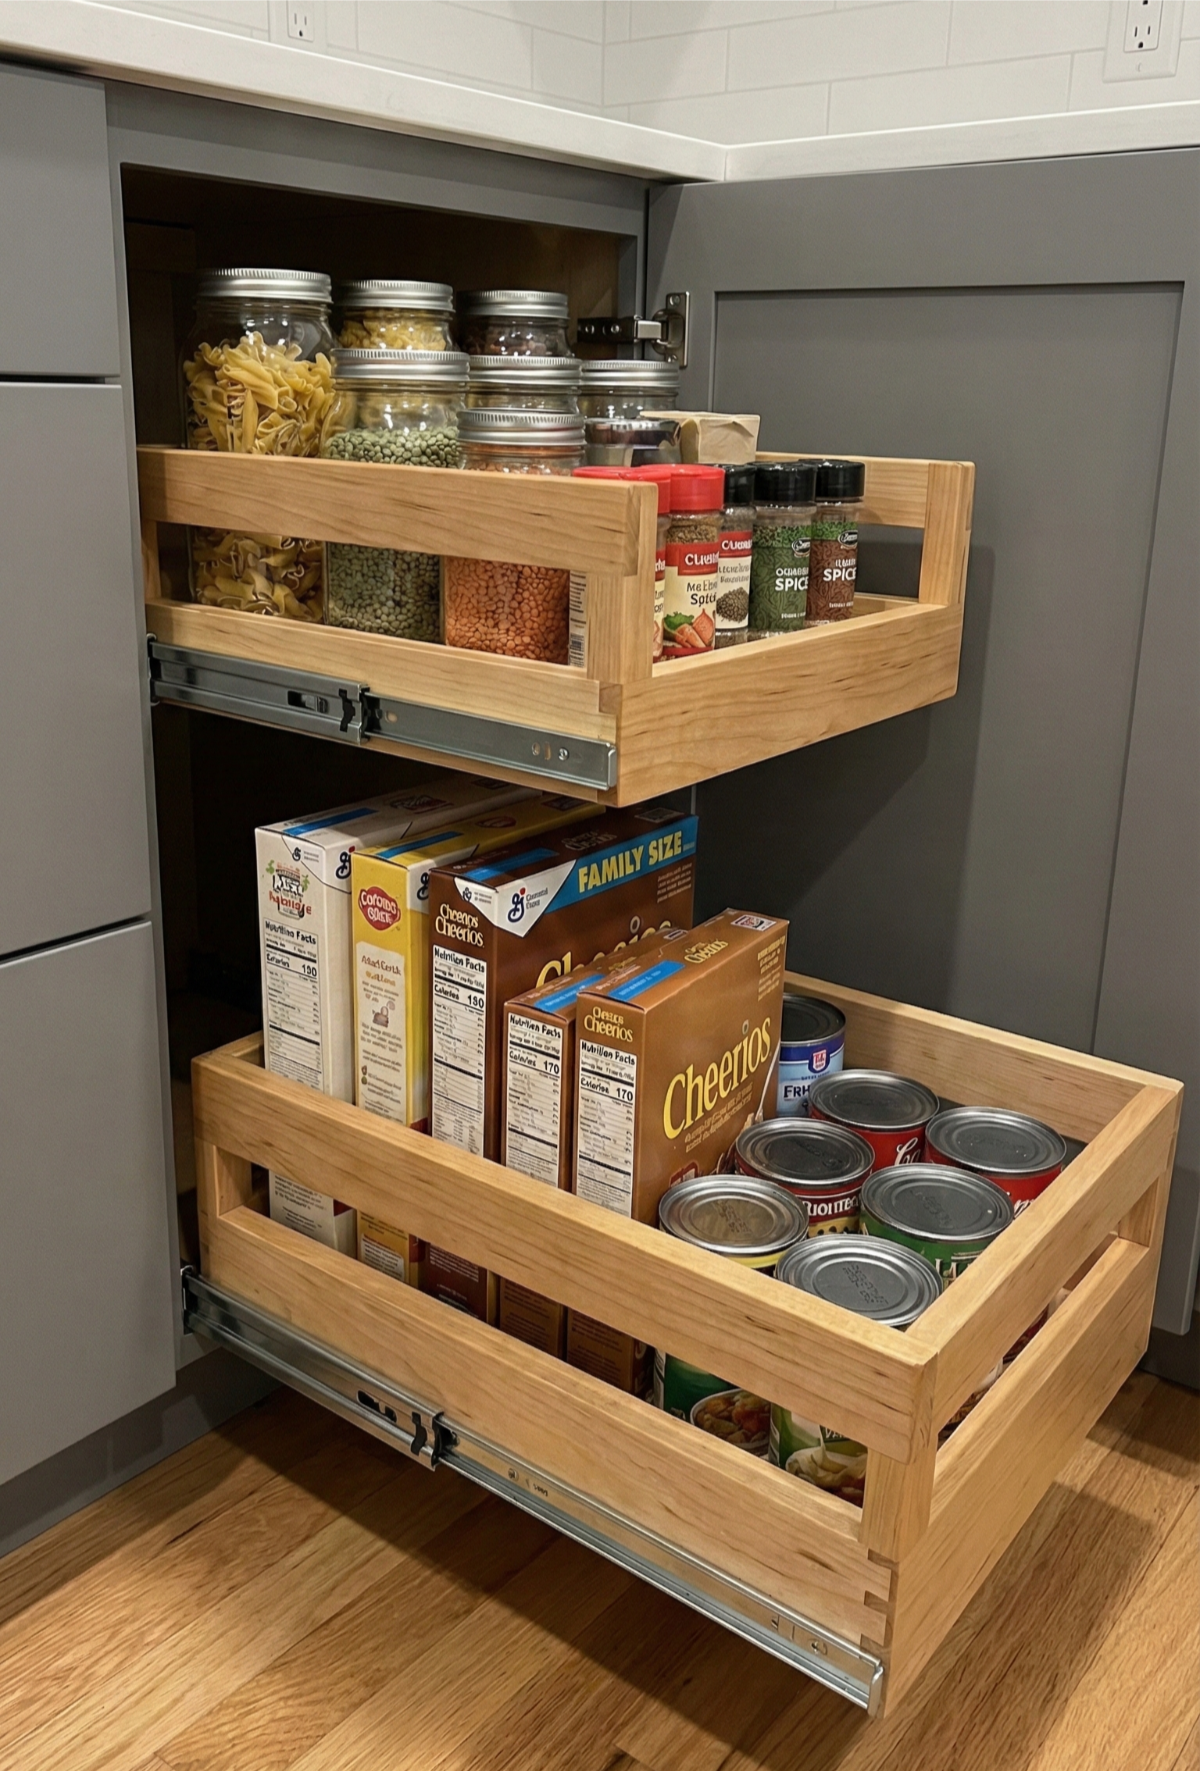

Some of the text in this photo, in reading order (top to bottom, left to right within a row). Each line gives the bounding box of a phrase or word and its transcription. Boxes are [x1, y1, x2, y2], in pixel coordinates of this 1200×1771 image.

[578, 845, 644, 893] FAMILY
[648, 831, 682, 866] SIZE
[435, 916, 484, 948] Cheerios
[584, 1015, 634, 1042] Cheerios
[543, 1061, 560, 1075] 170
[663, 1017, 771, 1139] Cheerios
[616, 1088, 633, 1102] 170
